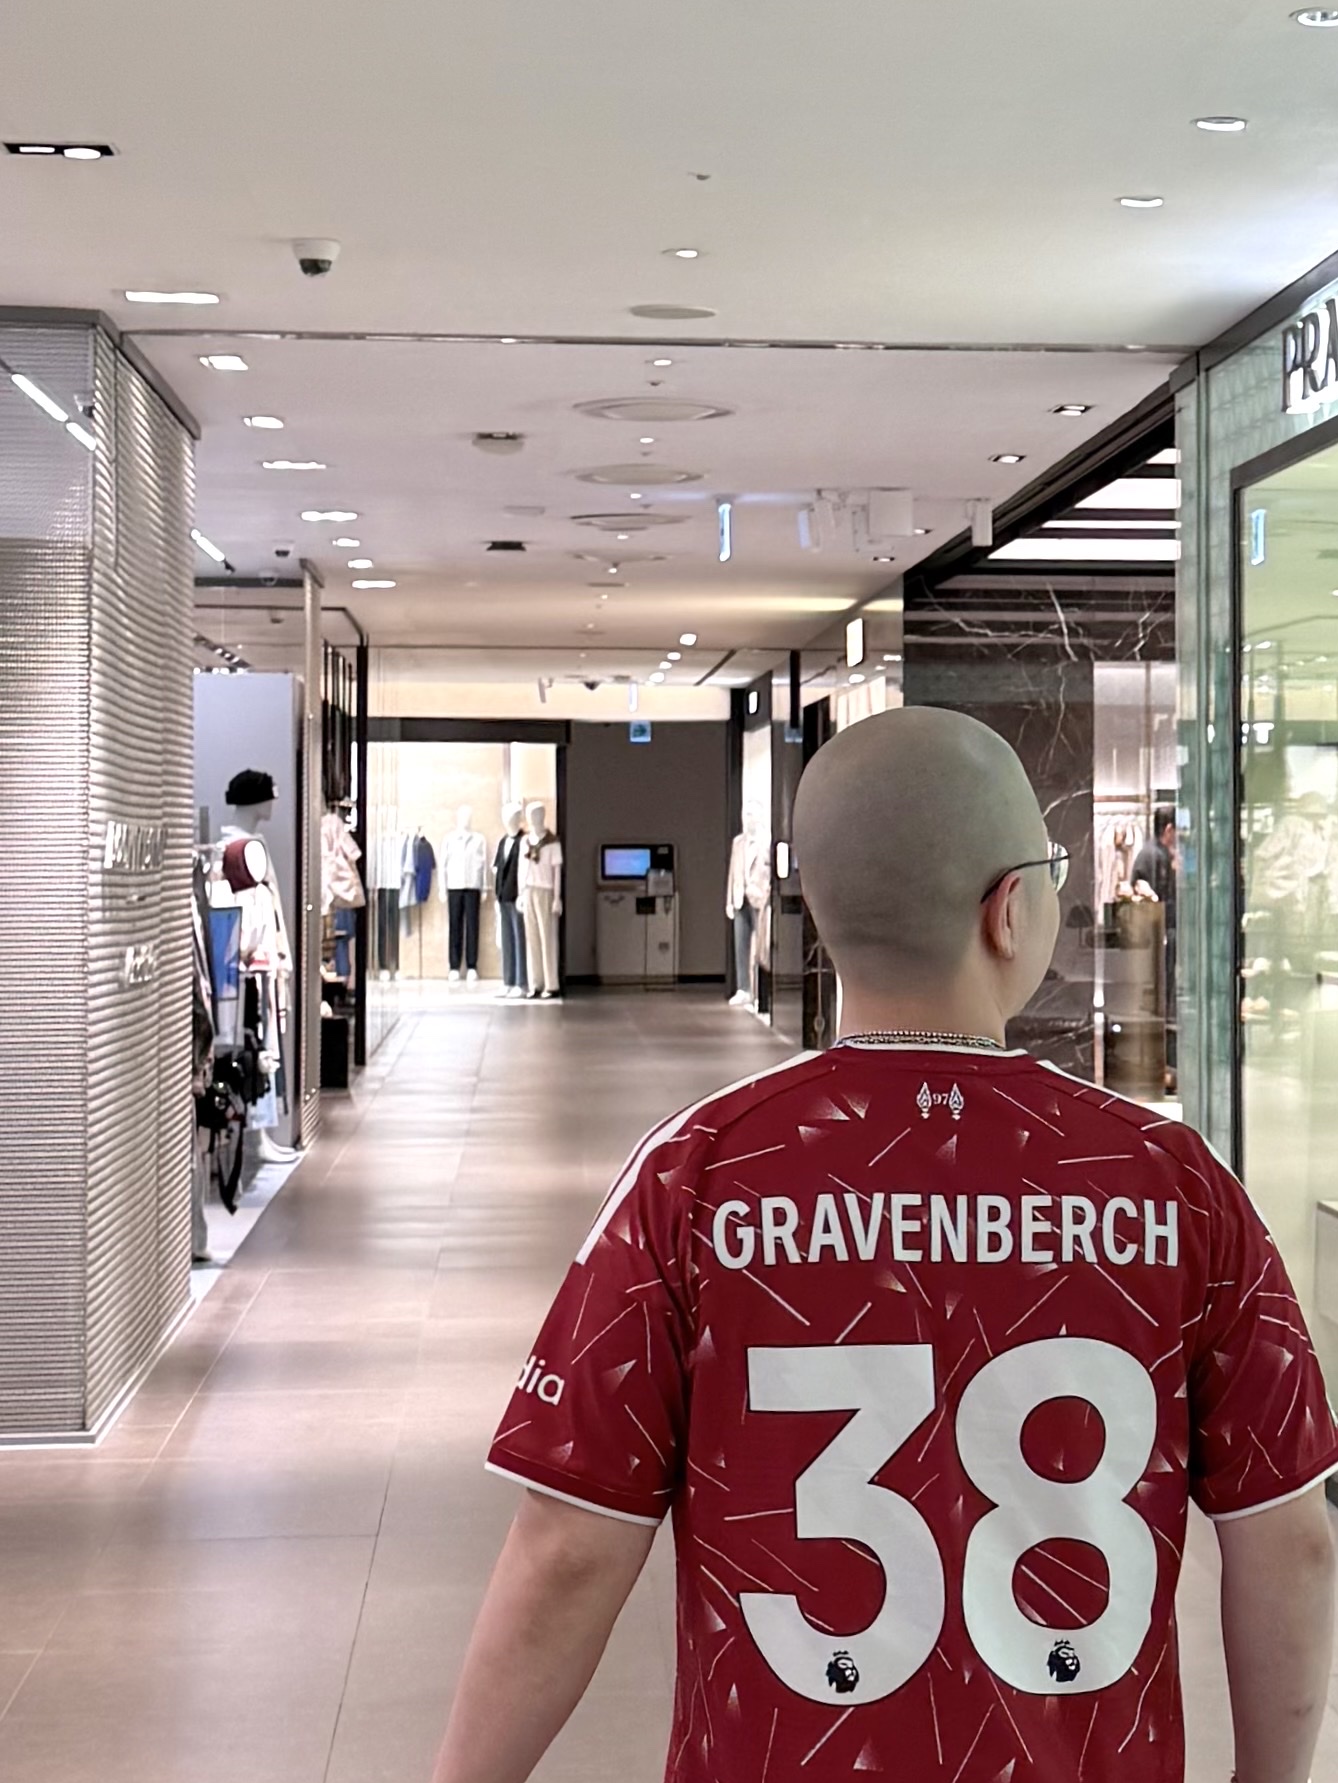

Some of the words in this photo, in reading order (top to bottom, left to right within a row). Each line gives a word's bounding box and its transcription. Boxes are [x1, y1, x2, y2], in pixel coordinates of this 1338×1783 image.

[932, 1093, 949, 1105] 97
[712, 1192, 1179, 1270] GRAVENBERCH
[739, 1336, 1158, 1706] 38
